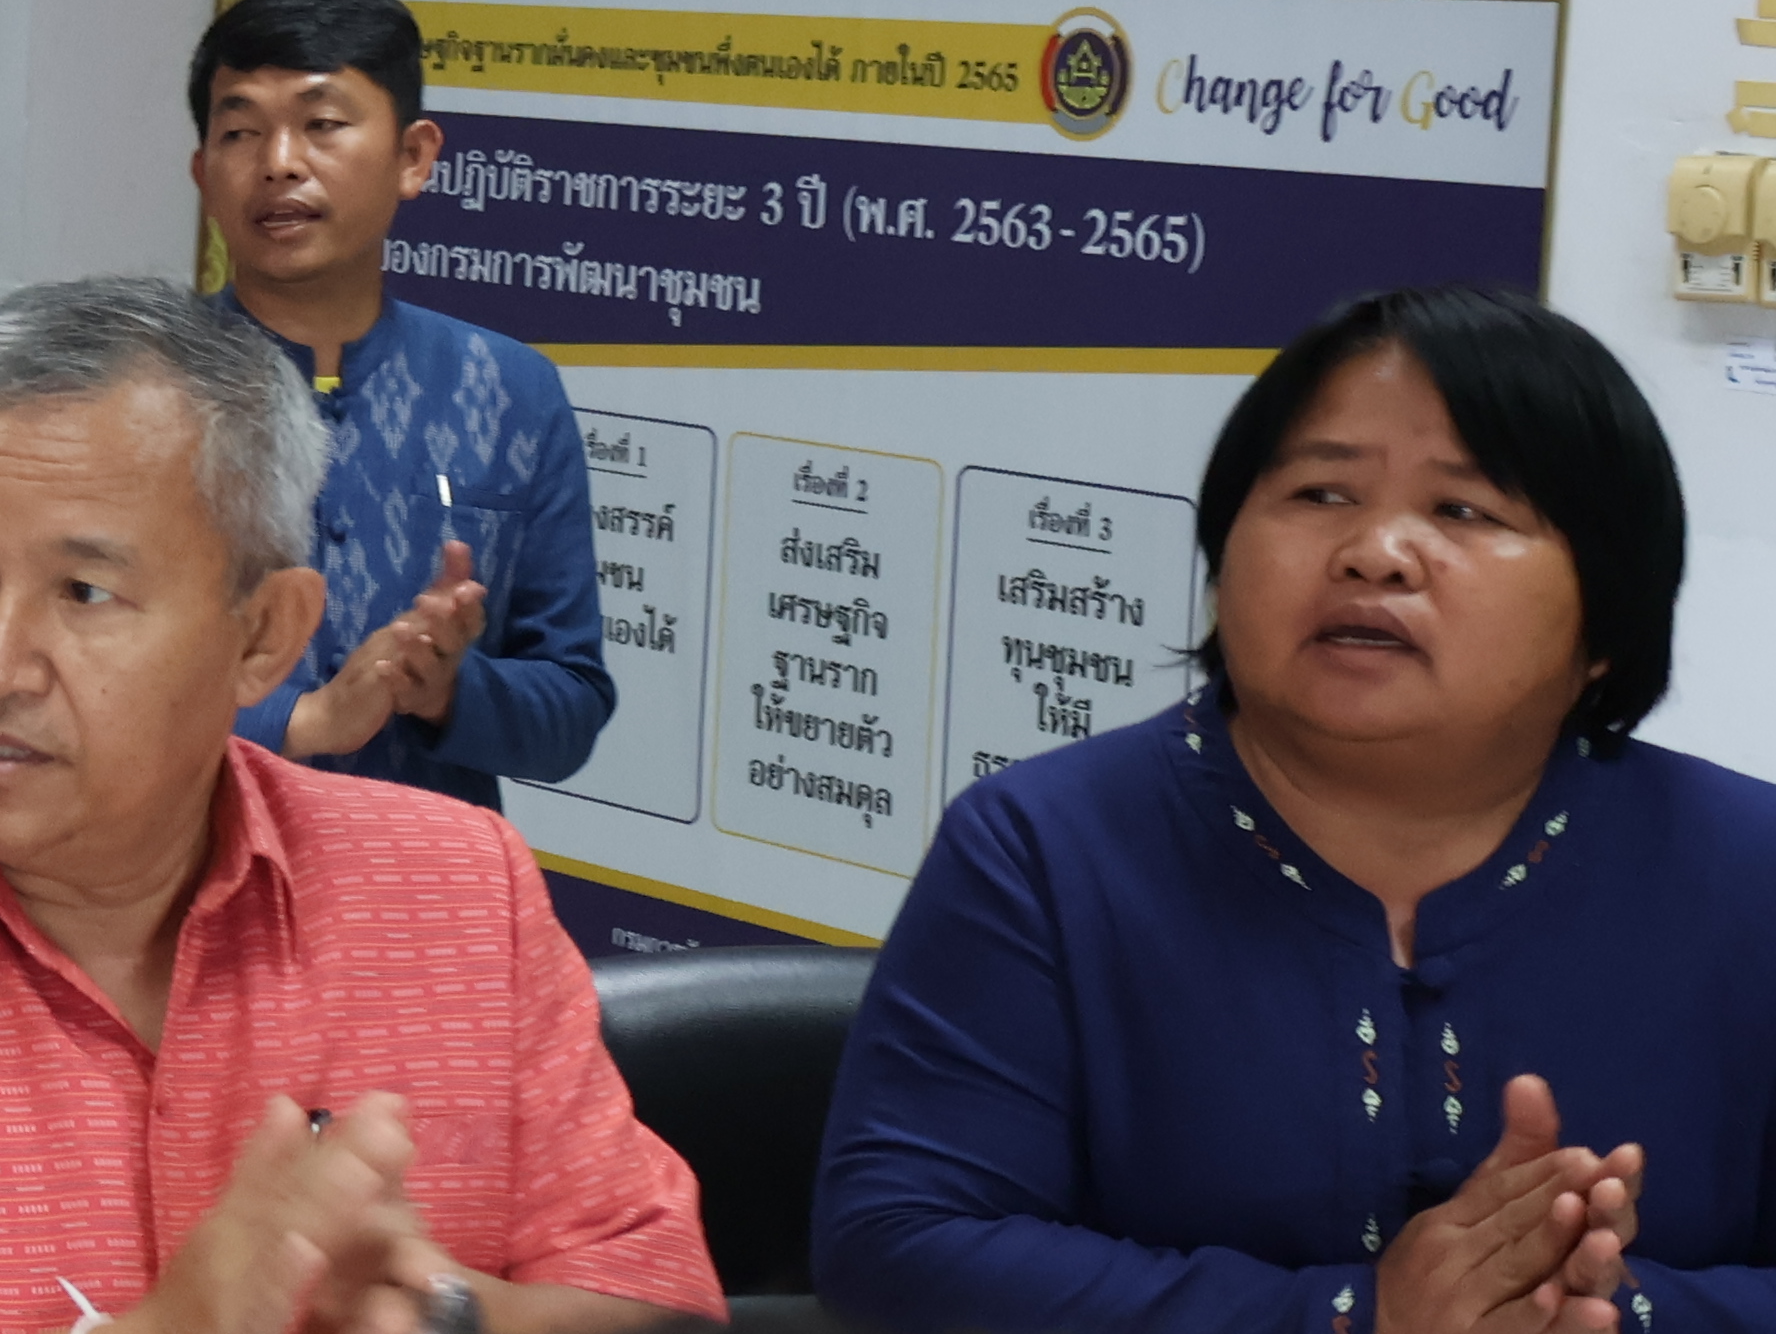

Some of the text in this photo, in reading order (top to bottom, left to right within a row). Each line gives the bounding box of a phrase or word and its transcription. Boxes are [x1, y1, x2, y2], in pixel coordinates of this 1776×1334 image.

[955, 60, 1020, 93] 2565
[1153, 53, 1519, 143] Change for Good
[759, 181, 785, 226] 3
[797, 173, 828, 231] ปี
[843, 186, 935, 243] (พ.ศ.
[636, 446, 647, 467] 1
[855, 479, 870, 502] 2
[595, 503, 676, 542] งสรรค์
[1098, 517, 1113, 541] 3
[779, 526, 881, 580] ส่งเสริม
[767, 591, 890, 646] เศรษฐกิจ
[998, 568, 1144, 626] เสริมสร้าง
[773, 649, 879, 697] ฐานราก
[1002, 635, 1133, 692] ทุนชุมชน
[750, 683, 893, 758] ให้ขยายตัว
[748, 754, 893, 830] อย่างสมดุล
